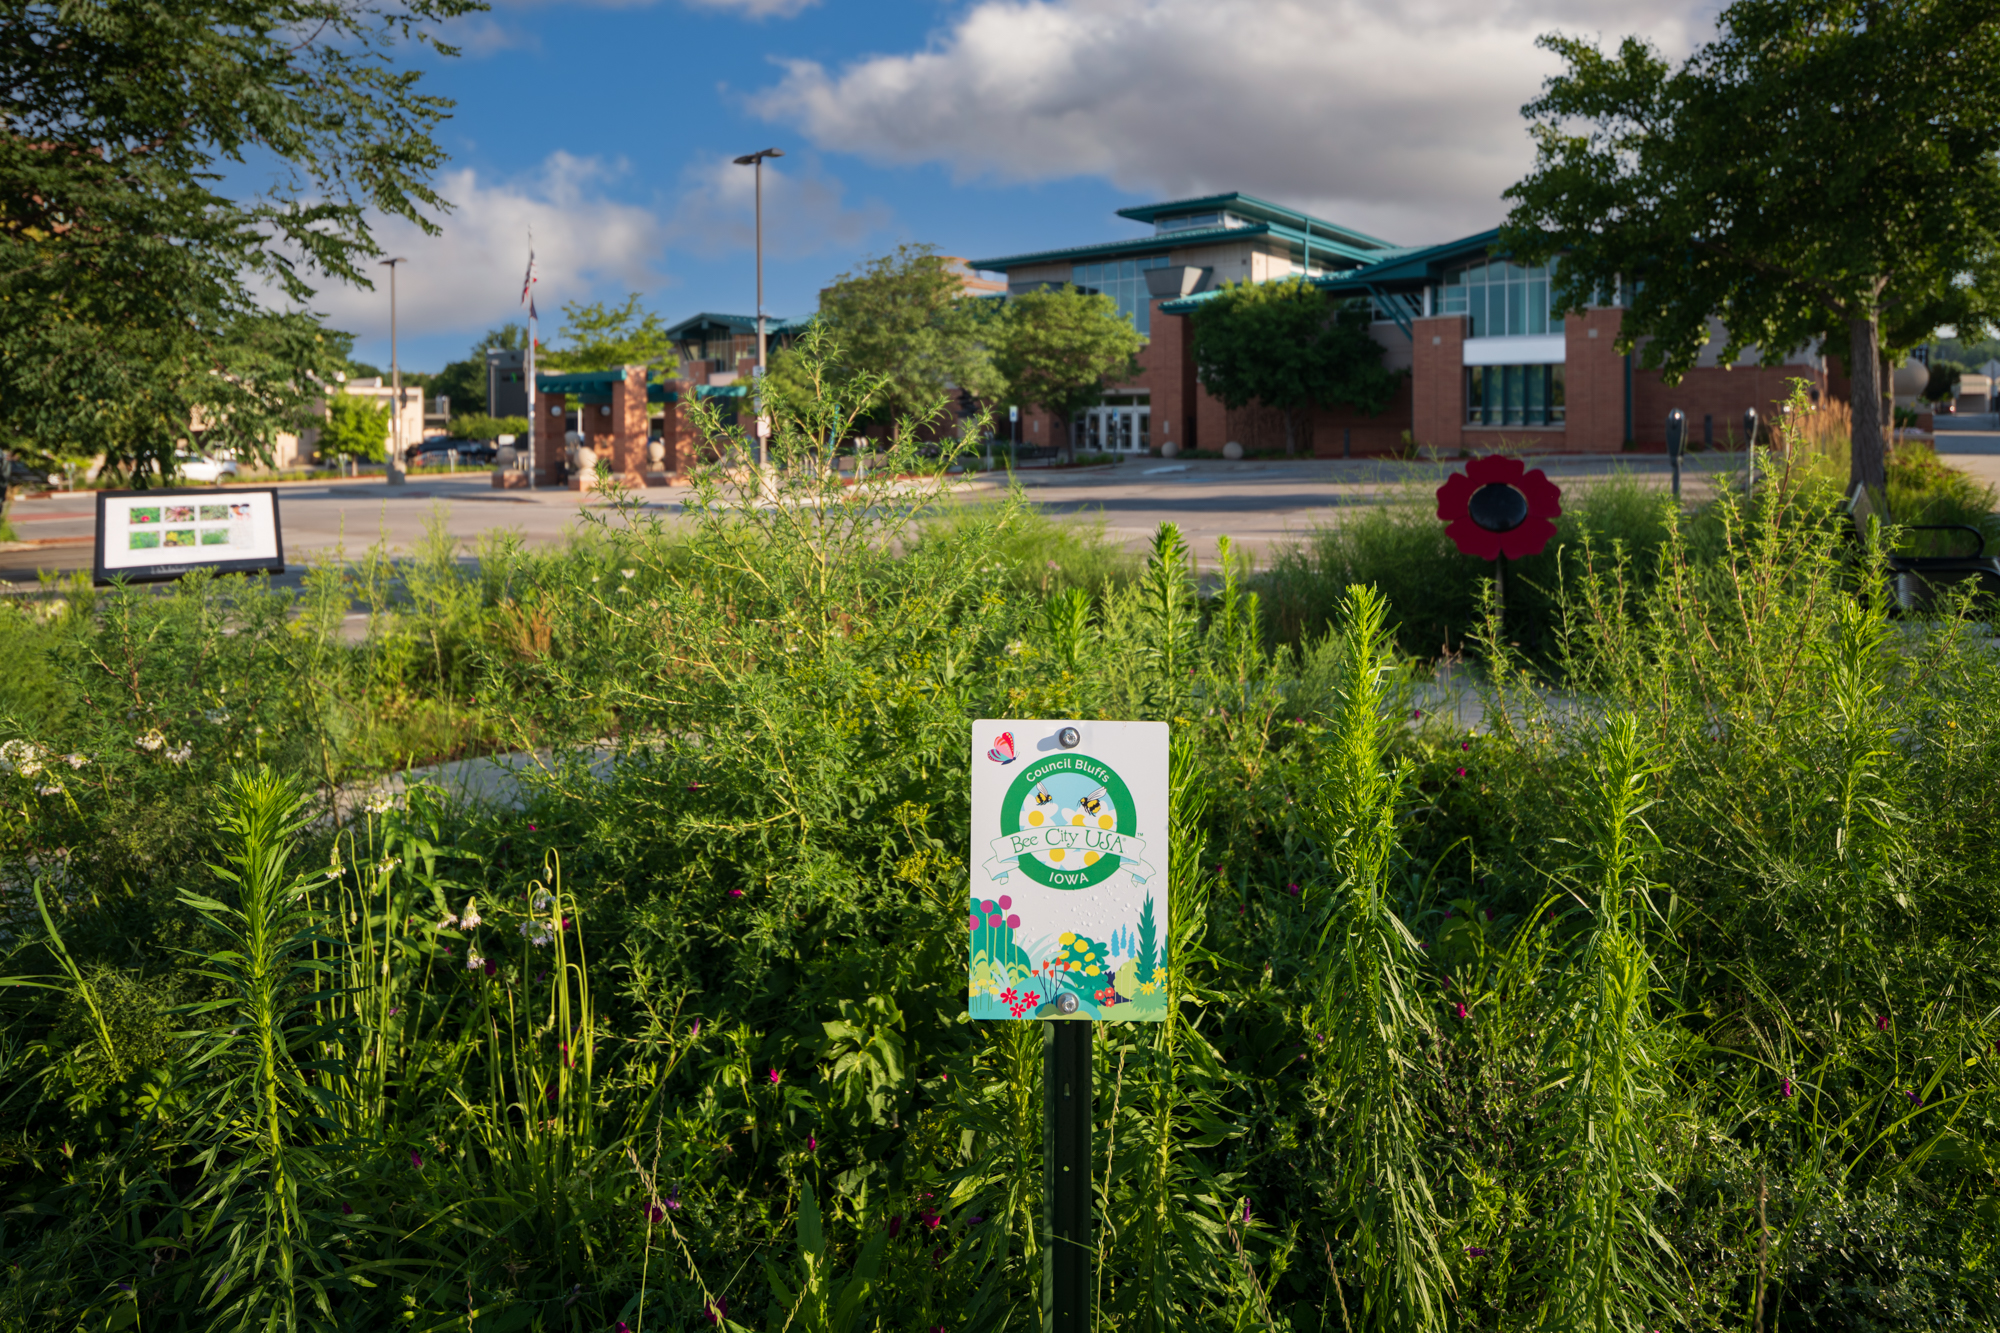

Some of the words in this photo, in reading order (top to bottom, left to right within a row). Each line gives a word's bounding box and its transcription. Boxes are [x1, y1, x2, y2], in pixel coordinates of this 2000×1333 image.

[1026, 758, 1071, 782] Council
[1075, 759, 1110, 783] Bluffs
[1010, 835, 1039, 854] Bee
[1045, 828, 1079, 848] City
[1085, 829, 1124, 854] USA
[1049, 872, 1089, 885] IOWA
